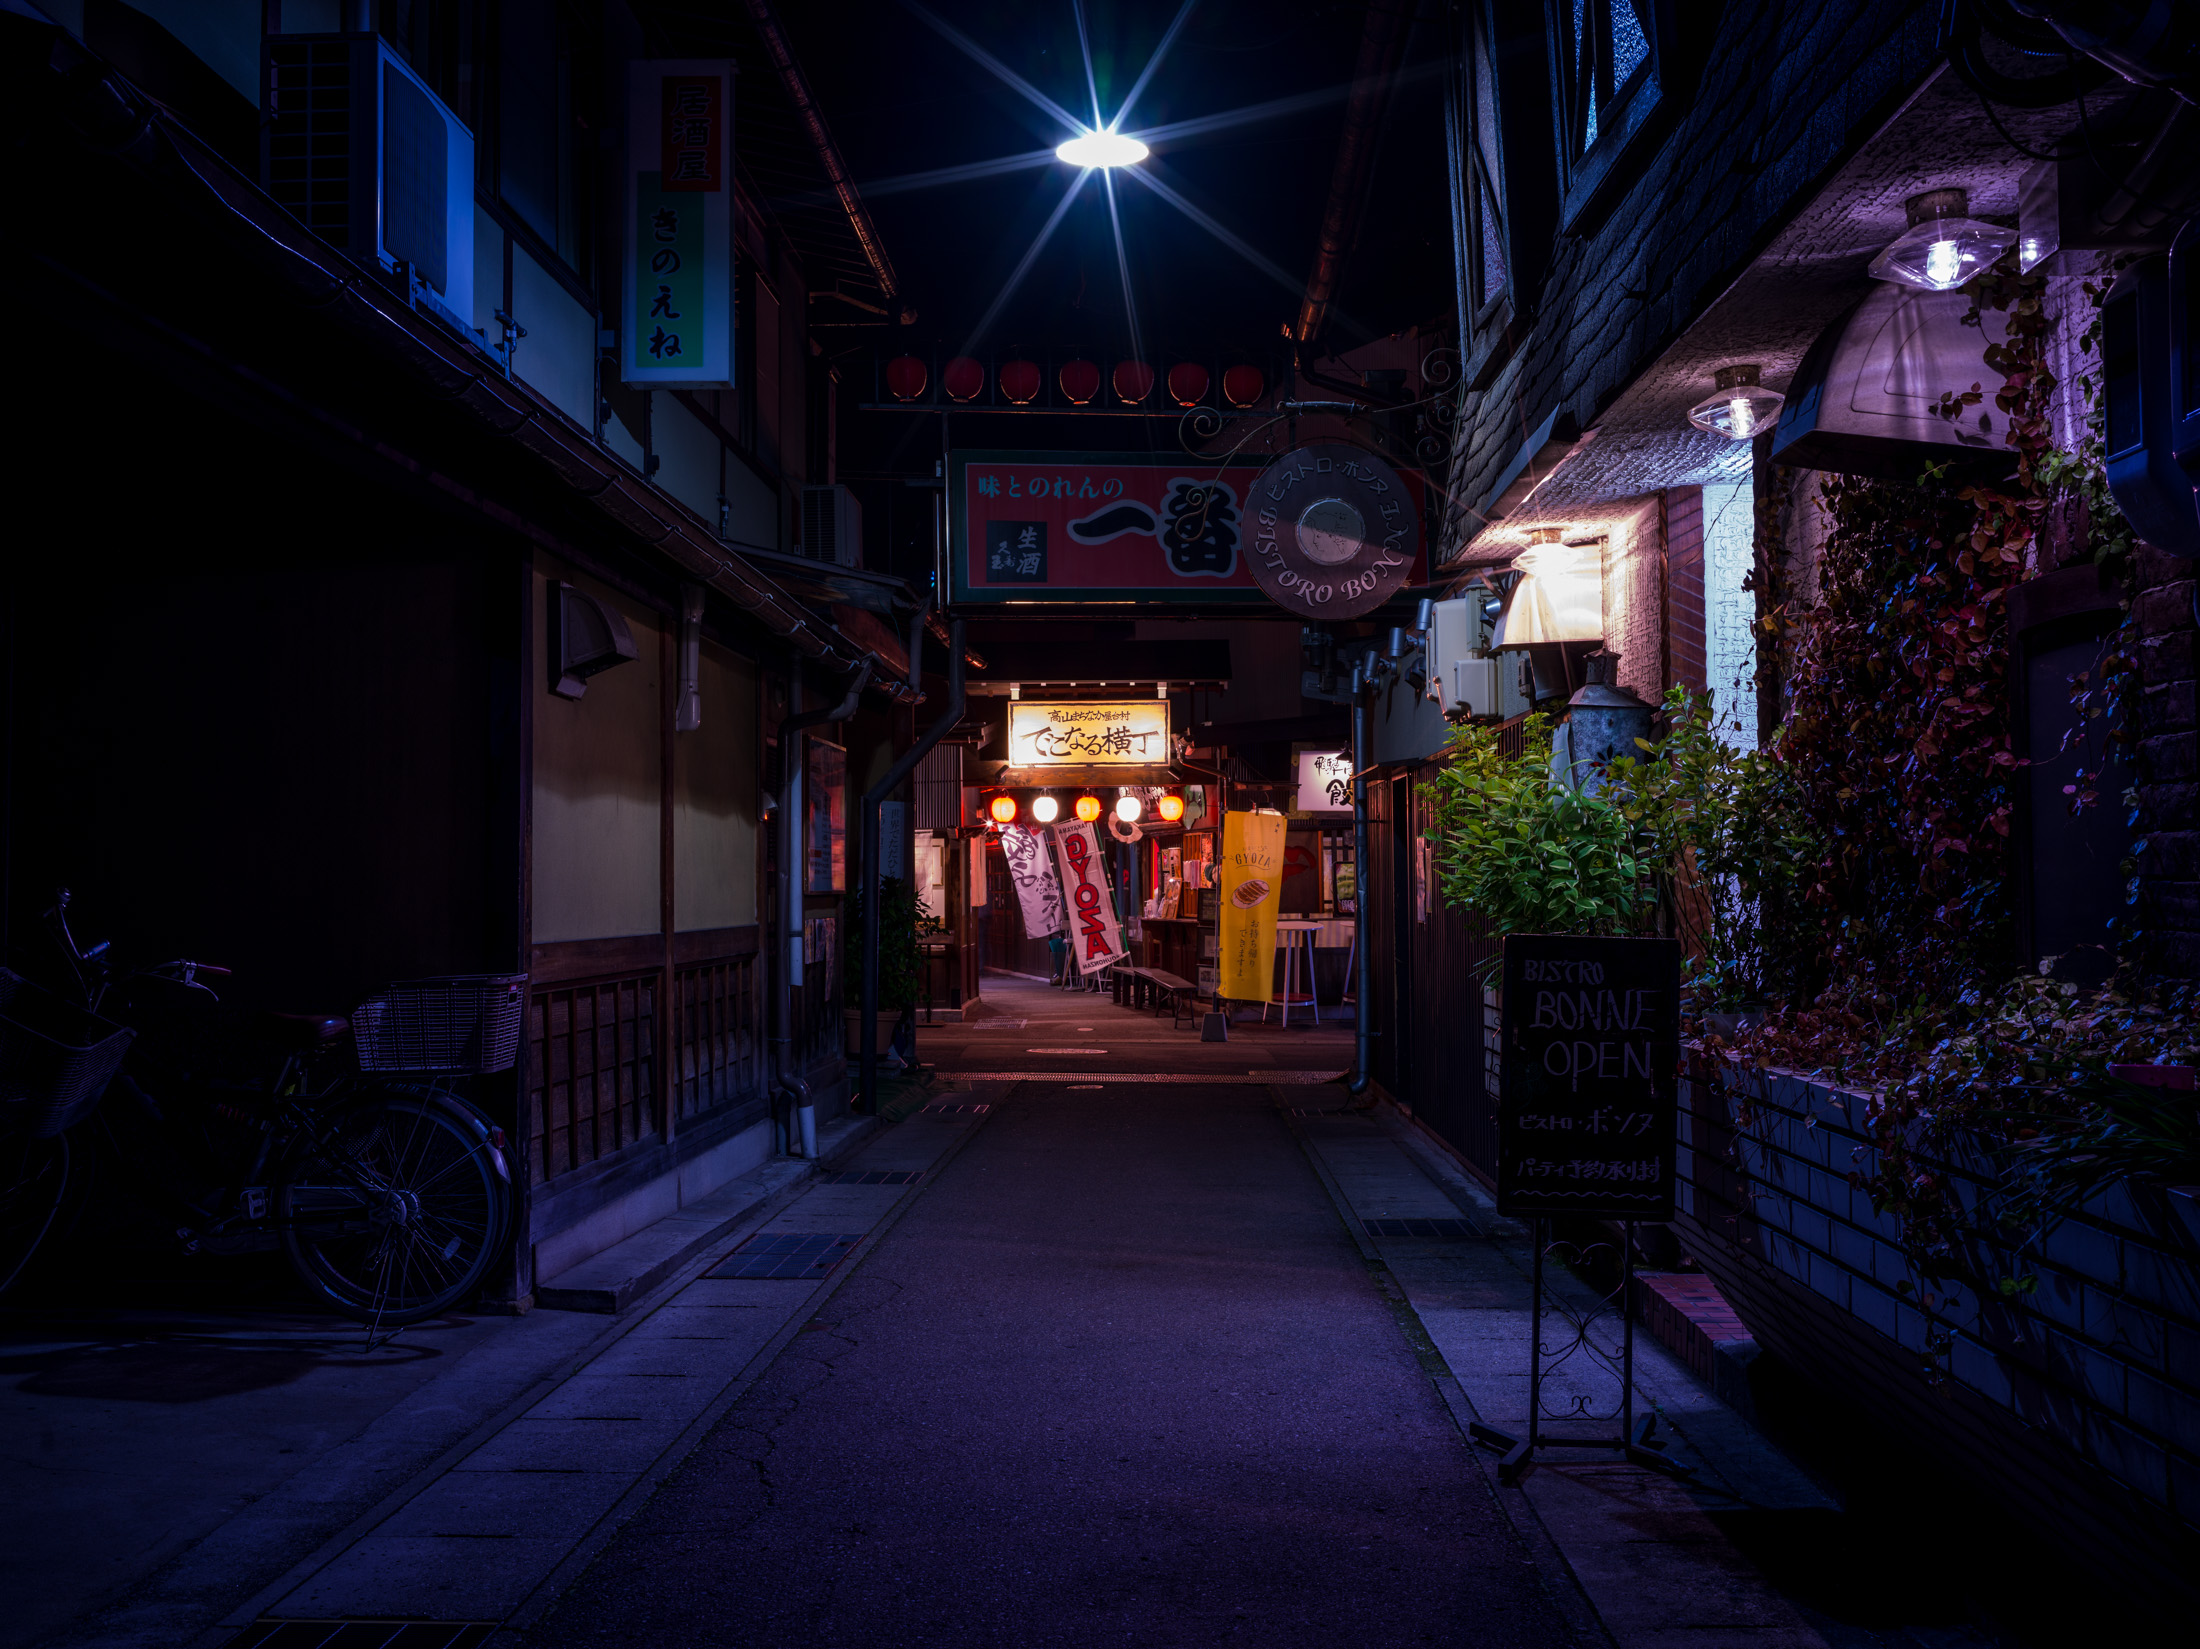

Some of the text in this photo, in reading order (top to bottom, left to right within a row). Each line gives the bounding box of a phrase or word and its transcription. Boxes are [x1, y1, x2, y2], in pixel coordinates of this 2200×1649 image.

[671, 86, 712, 182] 居酒屋
[648, 207, 682, 360] きのえね
[977, 474, 1124, 499] 味とのれんの
[1016, 526, 1043, 576] 生酒
[1069, 480, 1240, 576] 一番
[1254, 499, 1409, 607] BISTORO BONNE
[1048, 709, 1131, 722] 高山まちなか屋台村
[1020, 725, 1159, 757] でこなる横丁
[1235, 853, 1271, 868] GYOZA
[1521, 959, 1606, 986] BISTRO
[1529, 989, 1663, 1033] BONNE
[1544, 1040, 1653, 1094] OPEN
